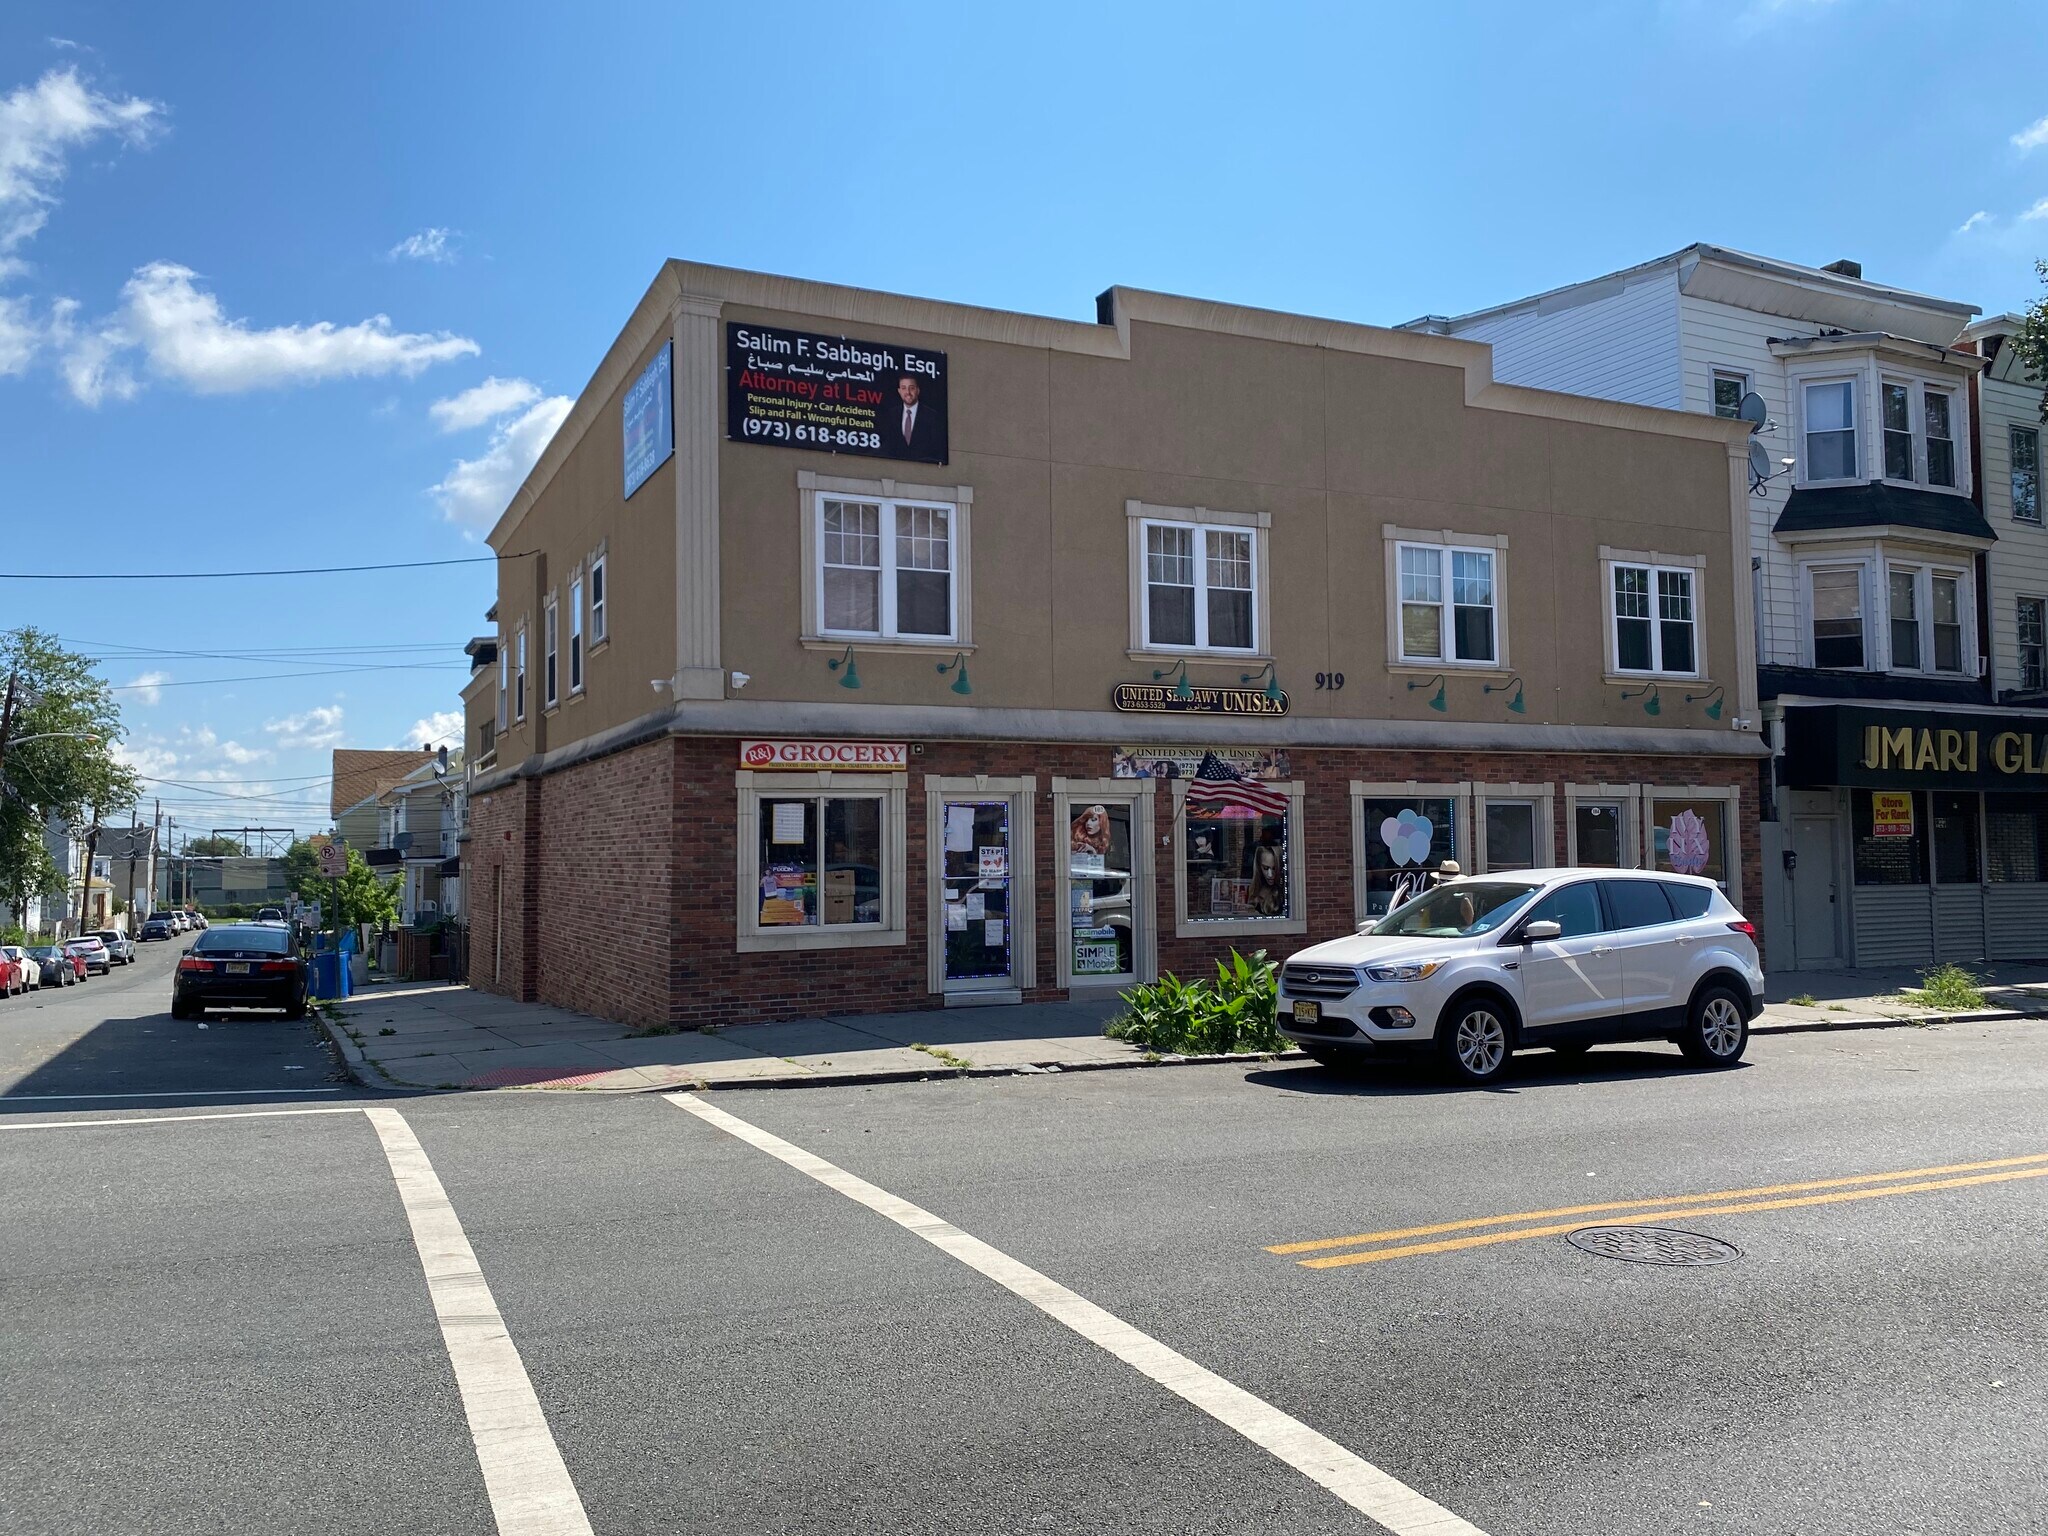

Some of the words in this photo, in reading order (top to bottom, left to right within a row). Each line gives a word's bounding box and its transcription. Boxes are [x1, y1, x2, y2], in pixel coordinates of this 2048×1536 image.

[736, 330, 791, 355] Salim
[797, 339, 811, 358] F.
[816, 341, 899, 372] Sabbagh,
[904, 354, 941, 379] Esq.
[748, 352, 783, 370] صباغ
[787, 363, 824, 377] سليم
[825, 370, 875, 382] المحامي
[739, 369, 818, 399] Attorney
[823, 383, 840, 399] at
[845, 384, 883, 404] Law
[747, 393, 786, 407] Personal
[786, 398, 813, 412] Injury
[819, 402, 834, 412] Car
[835, 404, 876, 417] Accidents
[749, 405, 766, 418] Slip
[767, 408, 785, 418] and
[786, 409, 802, 420] Fall
[808, 412, 848, 427] Wrongful
[848, 417, 874, 429] Death
[742, 417, 791, 441] (973)
[795, 425, 881, 449] 618-8638
[1315, 672, 1345, 691] 919
[1121, 687, 1164, 702] UNITED
[1223, 691, 1284, 713] UNISEX
[749, 745, 772, 762] R&J
[779, 743, 904, 763] GROCERY
[1136, 748, 1176, 757] UNITED
[1178, 748, 1226, 758] SENDWY
[1864, 725, 1978, 772] JMARI
[1881, 796, 1904, 808] Store
[1875, 809, 1890, 820] For
[1891, 808, 1910, 820] Rent
[1074, 928, 1115, 936] Lycamobile
[1076, 947, 1115, 958] SIMPLE
[1087, 959, 1116, 969] Mobile
